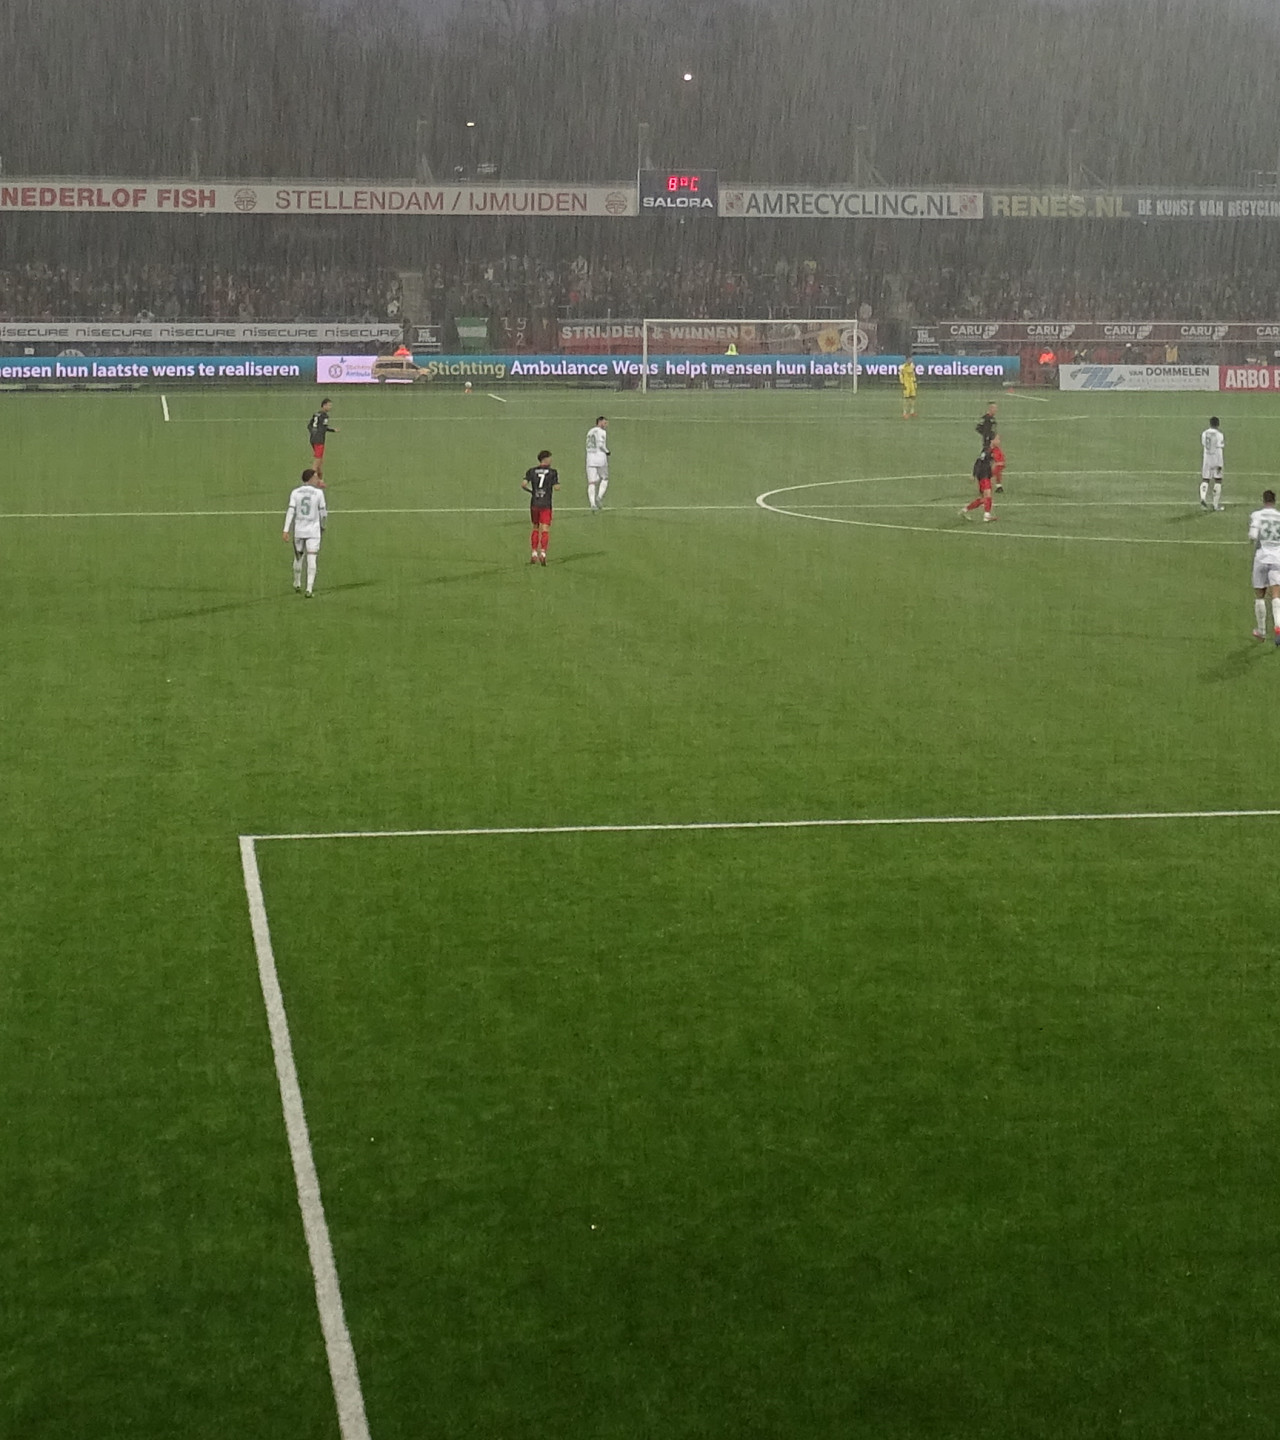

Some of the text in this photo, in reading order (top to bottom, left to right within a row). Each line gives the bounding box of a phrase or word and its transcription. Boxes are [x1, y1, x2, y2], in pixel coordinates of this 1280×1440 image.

[0, 187, 216, 208] NEDERLOF FISH
[275, 190, 588, 212] STELLENDAM / IJMUIDEN
[642, 197, 714, 209] SALORA
[745, 193, 958, 217] AMRECYCLING.NL
[991, 195, 1131, 219] RENES.NL
[1137, 199, 1152, 216] DE
[1156, 199, 1195, 216] KUNST
[1199, 200, 1224, 217] VAN
[561, 325, 739, 340] STRIJDEN & WINNEN
[950, 325, 983, 335] CARU
[1027, 325, 1059, 336] CARU
[1104, 325, 1136, 335] CARU
[1180, 326, 1212, 336] CARU
[56, 362, 88, 378] hun
[91, 362, 149, 378] laatste
[152, 364, 195, 378] wens
[198, 363, 215, 378] te
[218, 362, 300, 378] realiseren
[428, 360, 505, 379] Stichting
[510, 360, 608, 376] Ambulance
[612, 360, 659, 376] Wens
[666, 360, 707, 378] helpt
[711, 363, 771, 376] mensen
[776, 360, 807, 376] hun
[810, 361, 863, 376] laatste
[928, 361, 1004, 376] realiseren
[1145, 367, 1210, 377] DOMMELEN
[1225, 369, 1270, 389] ARBO
[537, 473, 546, 489] 7
[300, 495, 312, 517] 5
